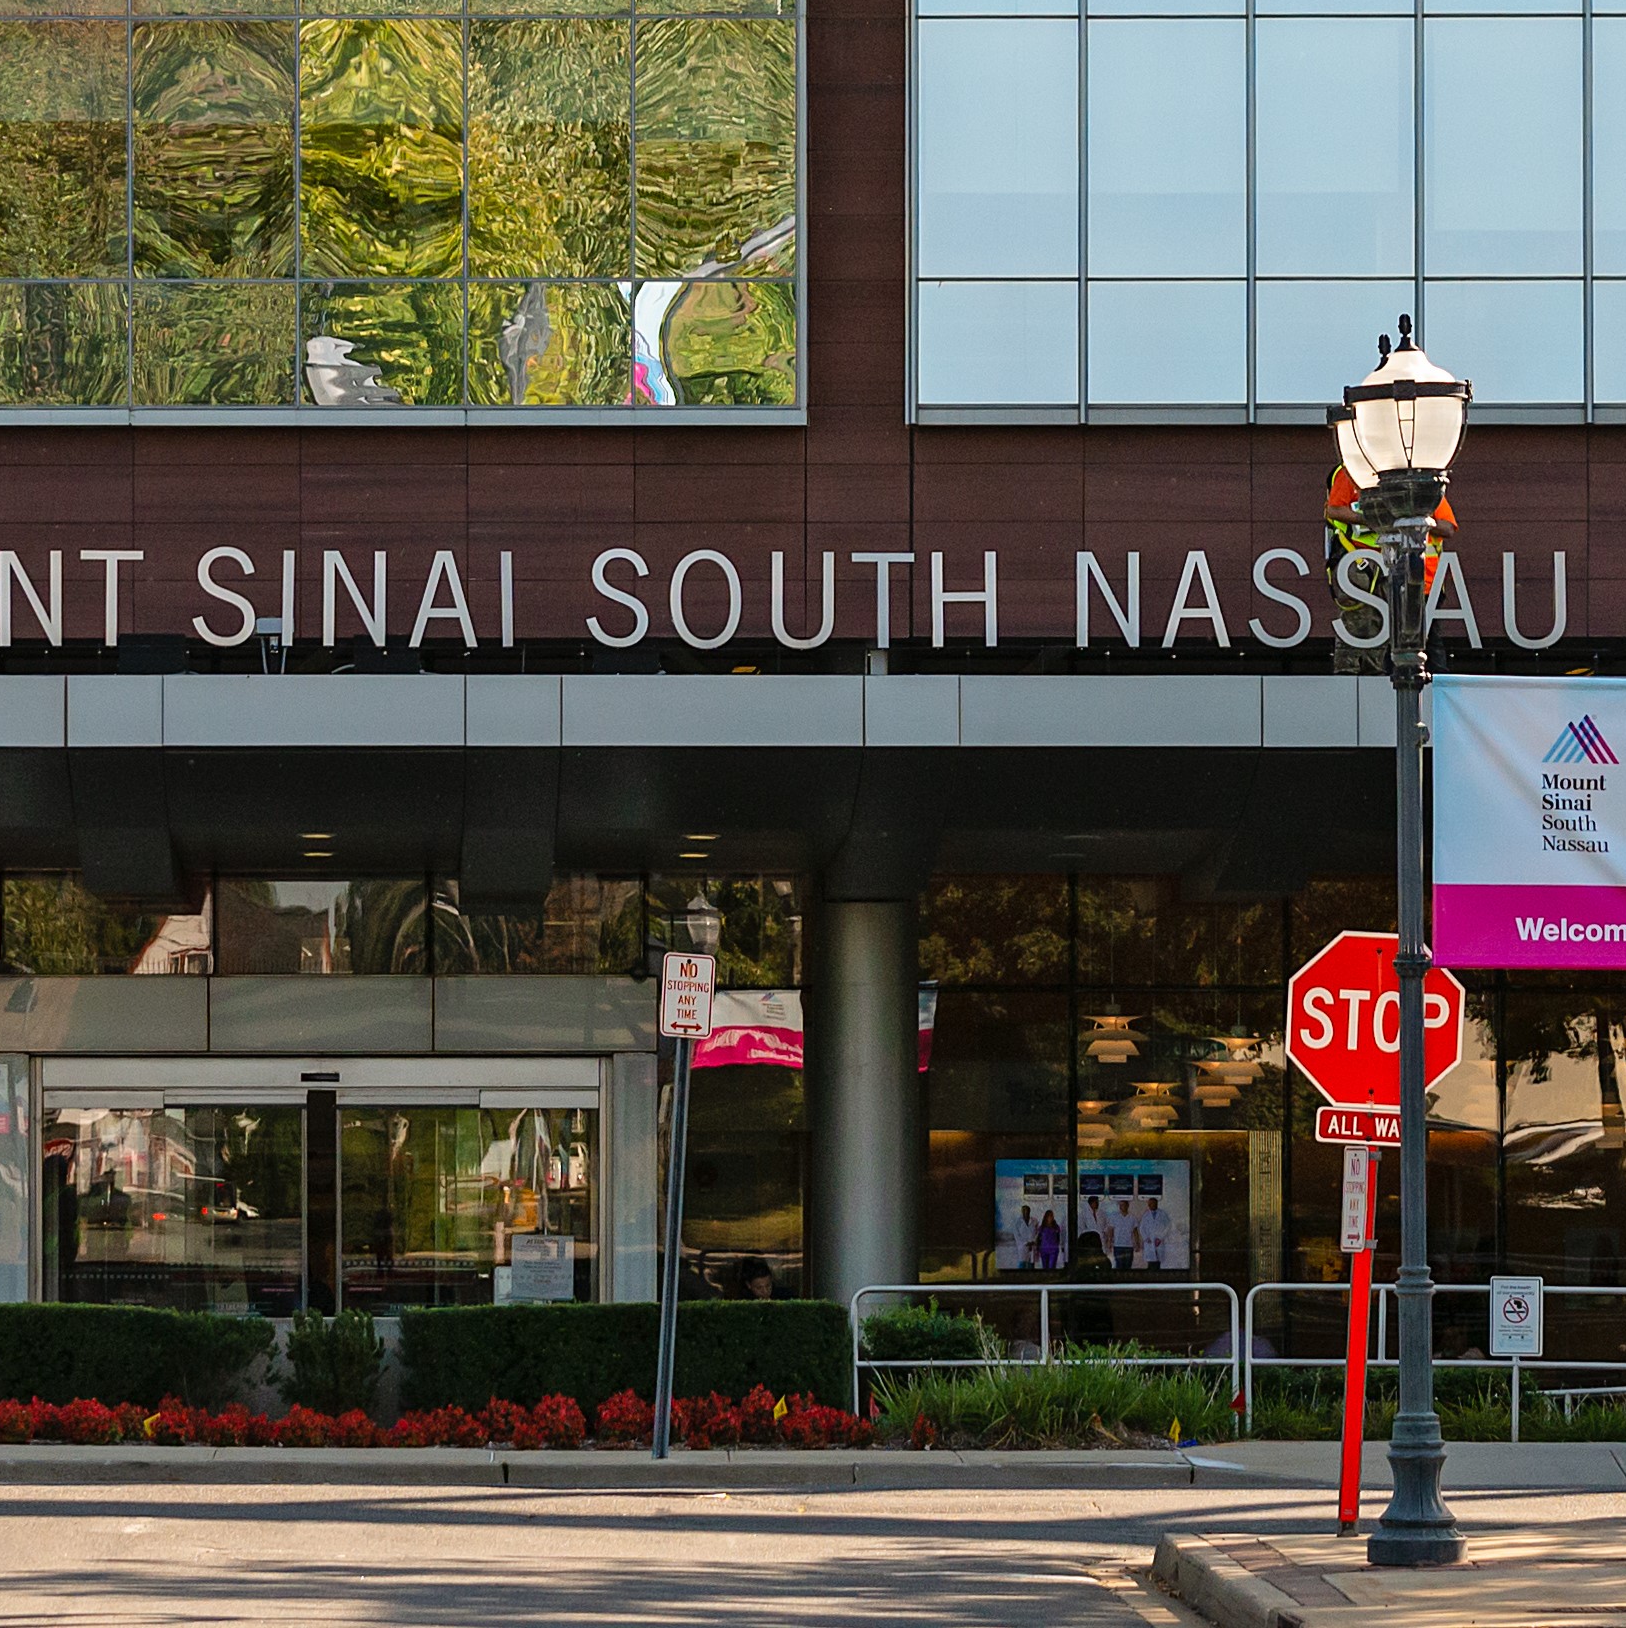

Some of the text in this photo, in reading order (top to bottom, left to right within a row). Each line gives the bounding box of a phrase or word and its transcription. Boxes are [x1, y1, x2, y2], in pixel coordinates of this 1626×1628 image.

[191, 545, 514, 649] SINAI
[584, 547, 999, 650] SOUTH
[1075, 546, 1568, 651] NASSAU
[1541, 773, 1607, 791] Mount
[1542, 793, 1593, 812] Sinai
[1542, 814, 1598, 832] South
[1542, 835, 1610, 853] Nassau
[680, 962, 698, 978] NO
[667, 979, 710, 994] STOPPING
[677, 994, 697, 1006] ANY
[676, 1008, 698, 1020] TIME
[1299, 986, 1451, 1054] STOP
[1327, 1114, 1401, 1138] ALL WA
[1351, 1158, 1361, 1176] NO
